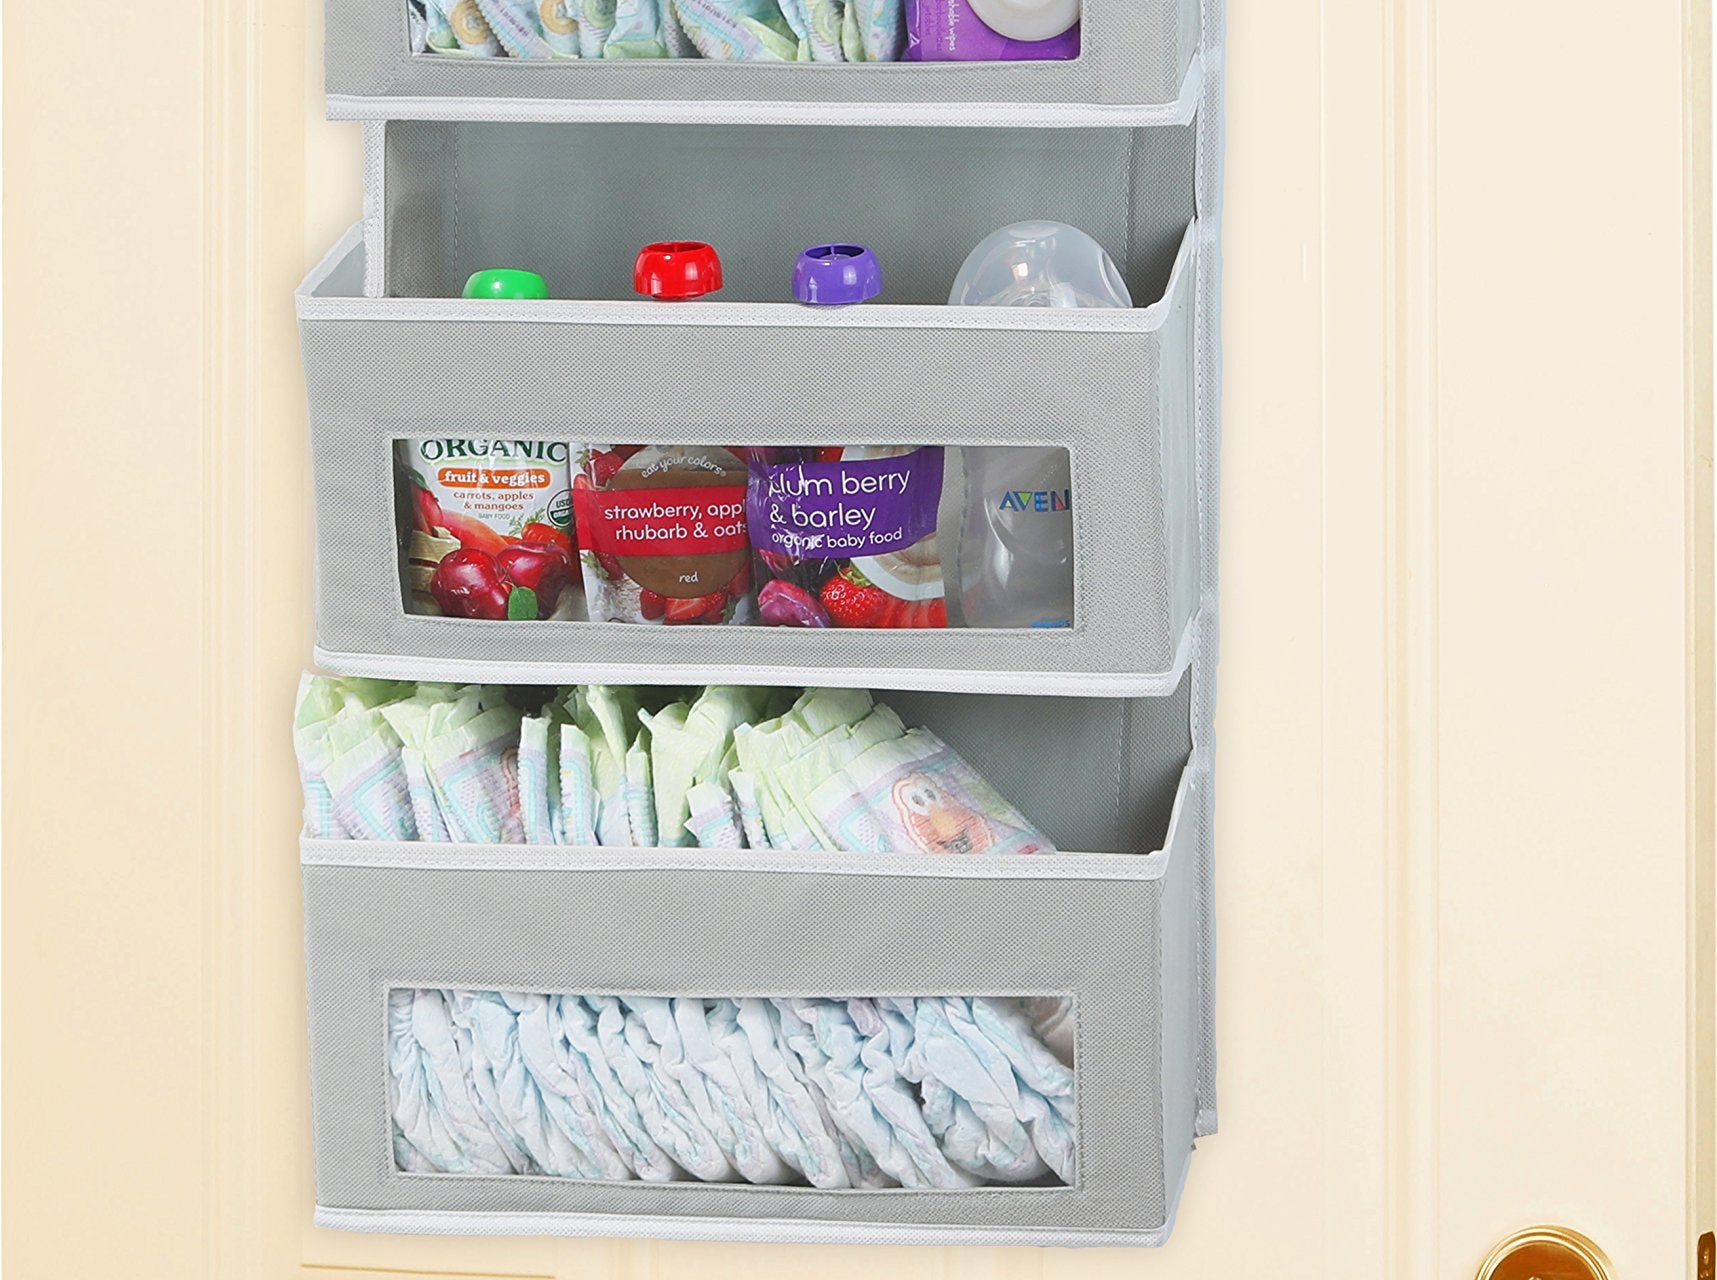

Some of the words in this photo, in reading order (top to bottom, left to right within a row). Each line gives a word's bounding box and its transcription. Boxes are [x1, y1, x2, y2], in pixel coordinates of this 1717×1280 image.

[420, 439, 568, 463] ORGANIC
[641, 463, 659, 479] eat
[659, 455, 687, 473] your
[444, 471, 477, 483] fruit
[479, 473, 489, 483] &
[491, 472, 545, 487] veggies
[841, 470, 911, 495] berry
[498, 491, 534, 502] apples
[463, 502, 473, 510] &
[474, 502, 524, 512] mangoes
[604, 502, 703, 520] strawberry,
[769, 503, 787, 524] &
[791, 502, 876, 531] barley
[615, 523, 688, 541] rhubarb
[693, 522, 709, 539] &
[771, 532, 825, 551] organic
[826, 534, 866, 549] baby
[869, 527, 903, 545] food
[678, 571, 699, 584] red
